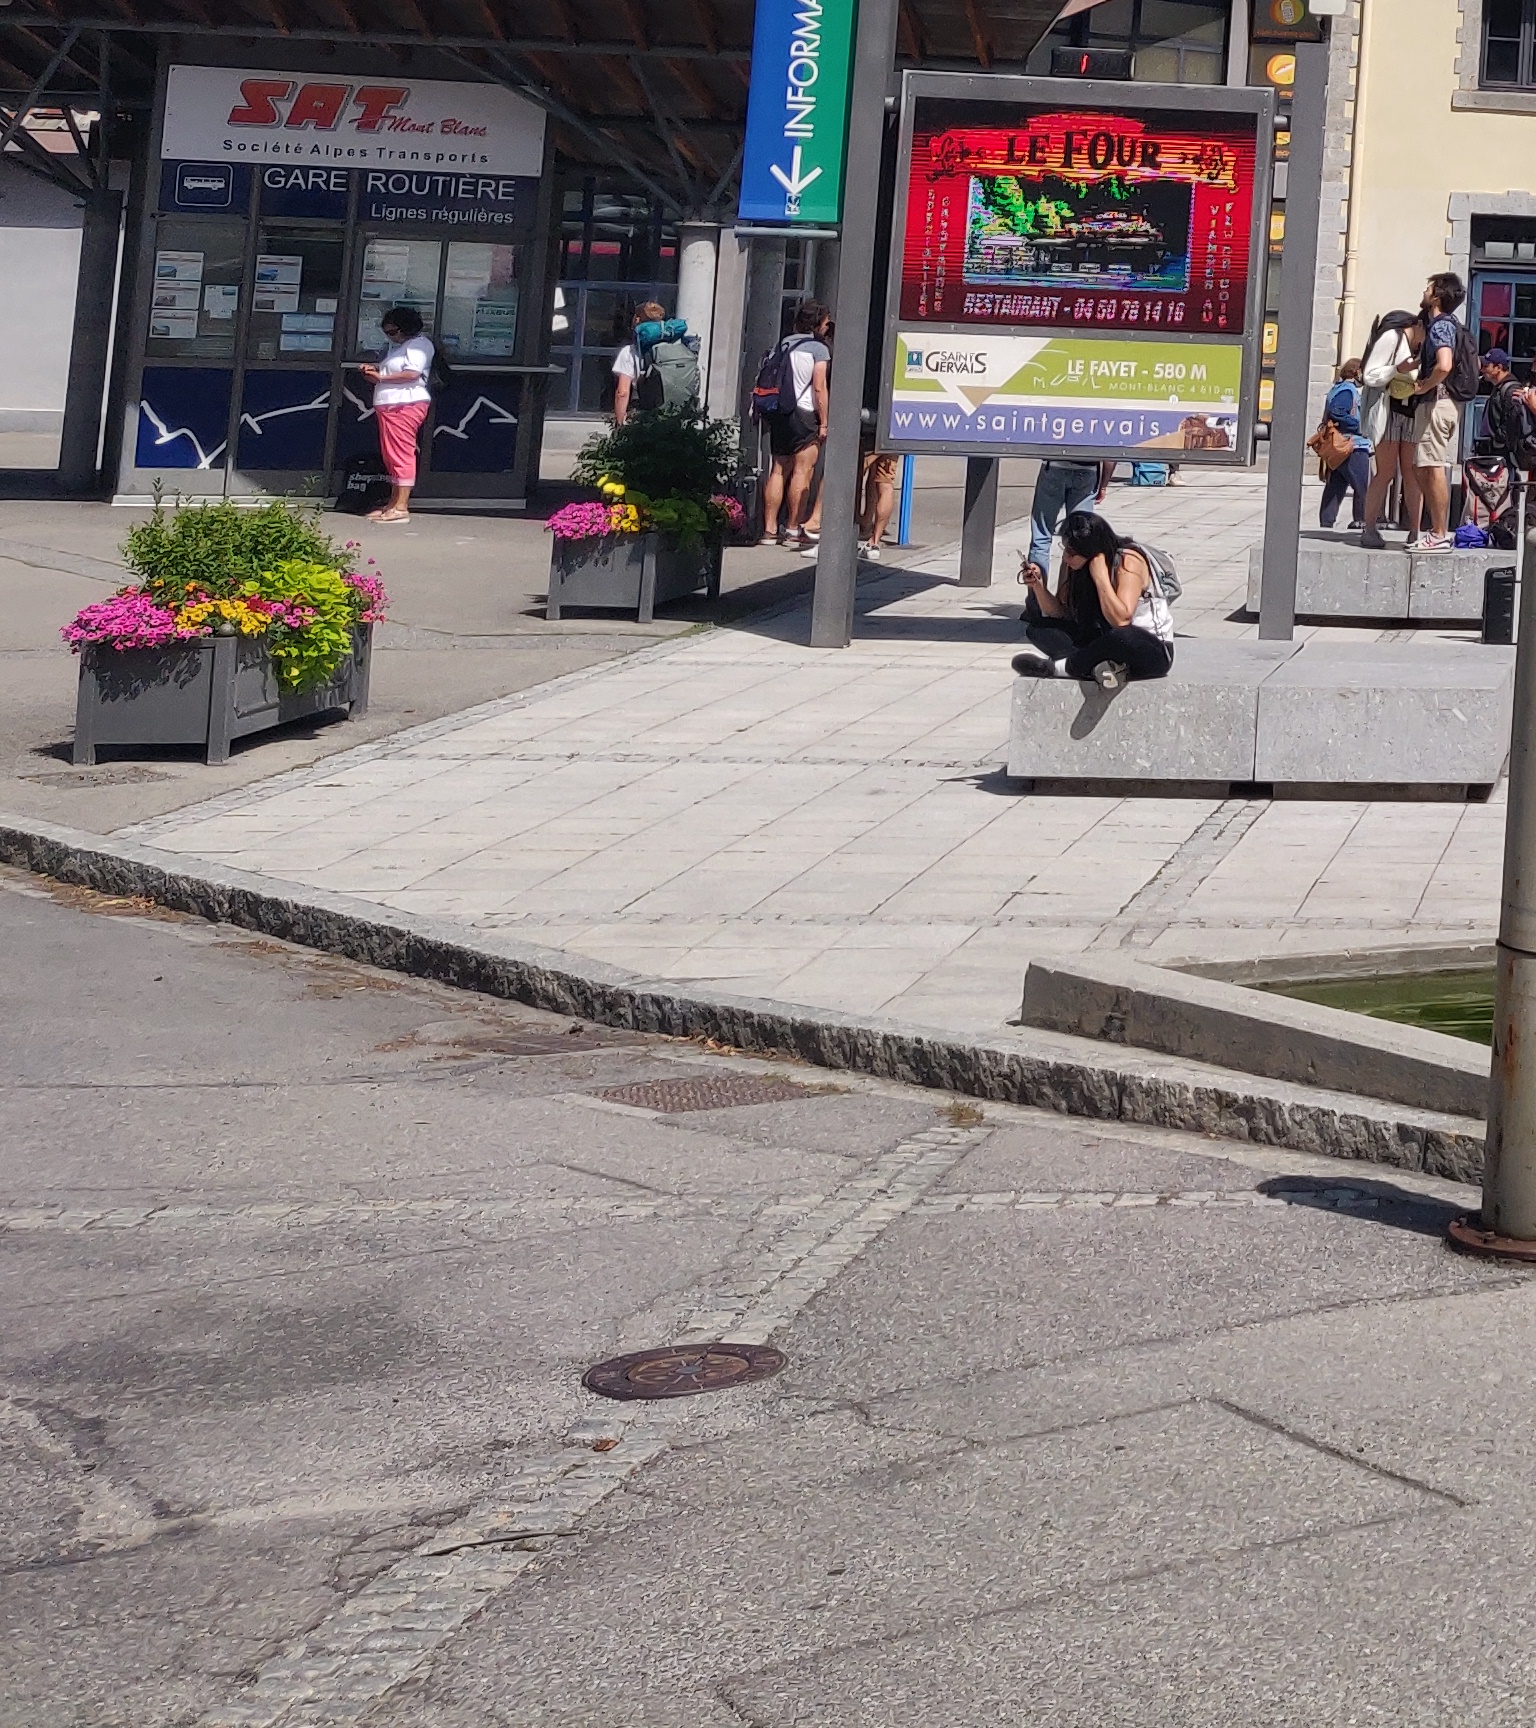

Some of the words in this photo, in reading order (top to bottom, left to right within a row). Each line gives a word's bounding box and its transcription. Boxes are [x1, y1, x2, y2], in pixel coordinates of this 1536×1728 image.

[227, 78, 410, 133] SAT
[385, 114, 435, 134] Mont
[440, 117, 489, 138] Blanc
[223, 138, 302, 155] Société
[310, 142, 369, 159] Alpes
[377, 146, 489, 164] Transports
[1006, 135, 1048, 165] LE
[1063, 130, 1163, 171] FOUR
[264, 167, 348, 192] GARE
[367, 172, 517, 201] ROUTIÈRE
[371, 203, 427, 222] Lignes
[432, 204, 514, 226] régulières
[925, 350, 988, 374] GERVAIS
[940, 351, 978, 362] SAINT
[1067, 359, 1084, 375] LE
[1090, 360, 1138, 378] FAYET
[1153, 363, 1186, 379] 580
[1191, 364, 1207, 381] M
[1109, 381, 1185, 394] MONT-BLANC
